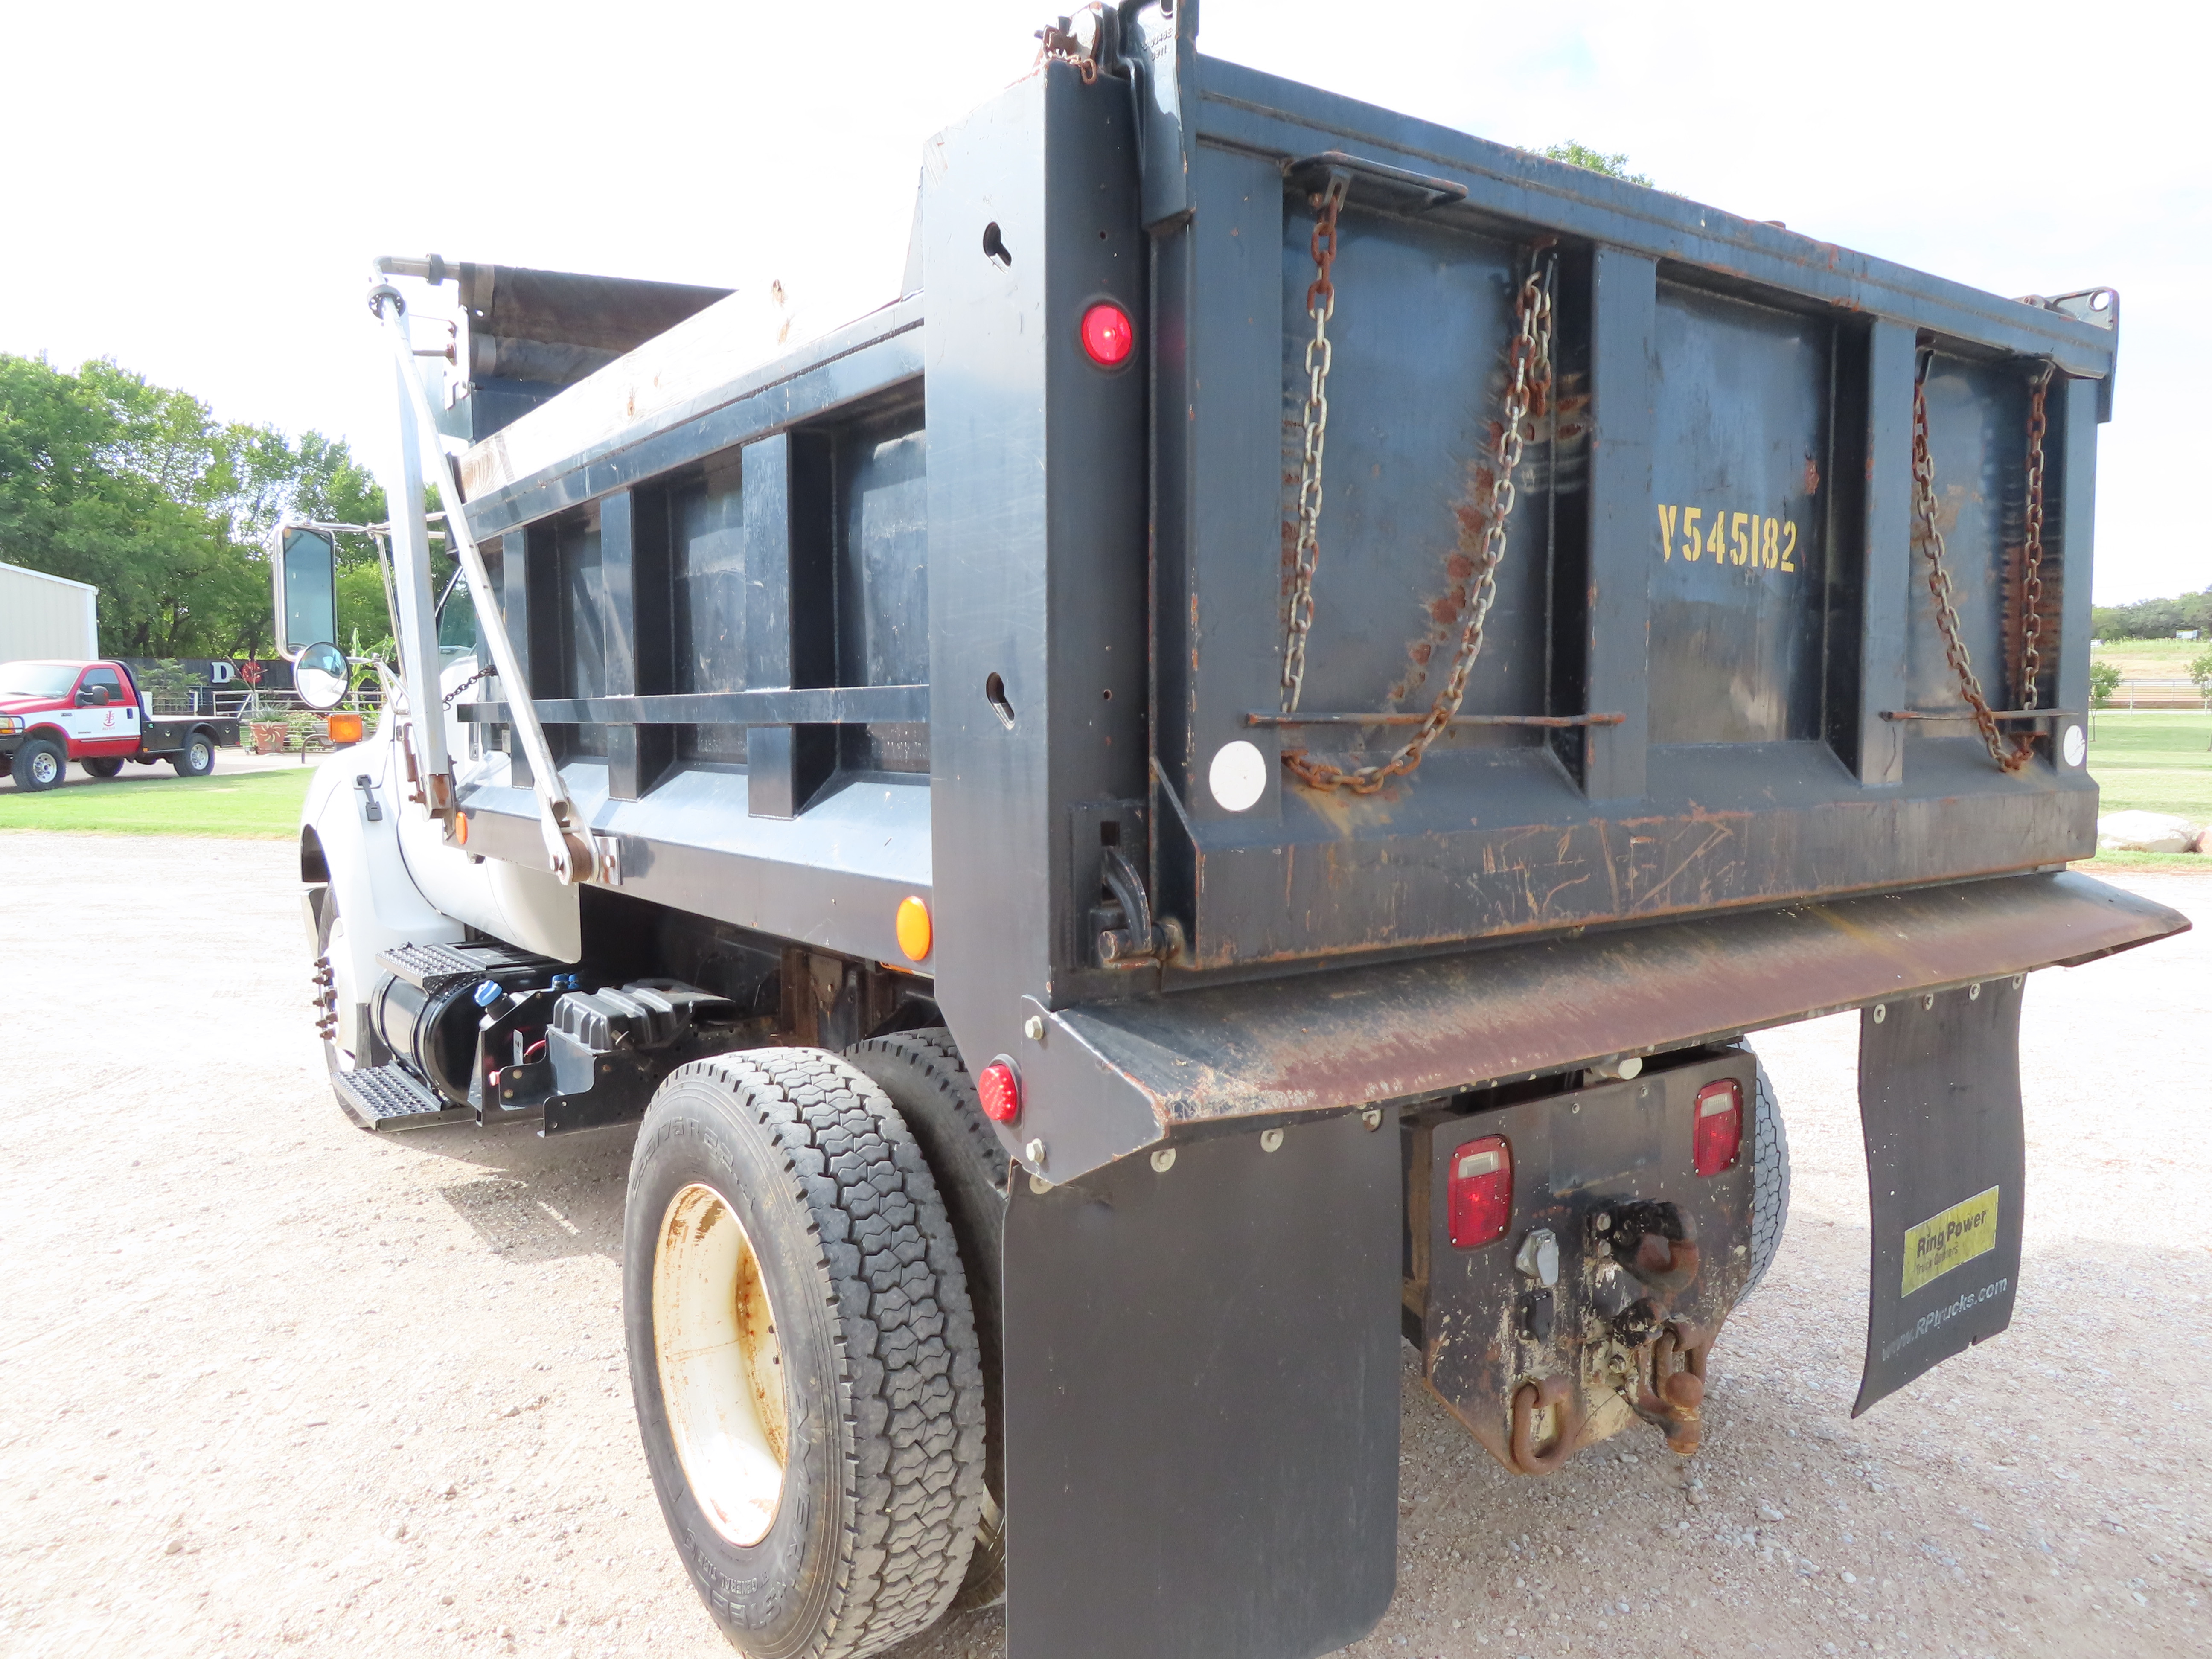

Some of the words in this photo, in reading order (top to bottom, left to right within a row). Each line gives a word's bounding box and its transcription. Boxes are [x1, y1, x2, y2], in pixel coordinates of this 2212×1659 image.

[1657, 504, 1797, 573] V545182
[211, 661, 234, 683] D
[1917, 1230, 1945, 1259] Ring
[1947, 1209, 1987, 1242] Power
[1882, 1277, 2008, 1362] www.RPtrucks.com
